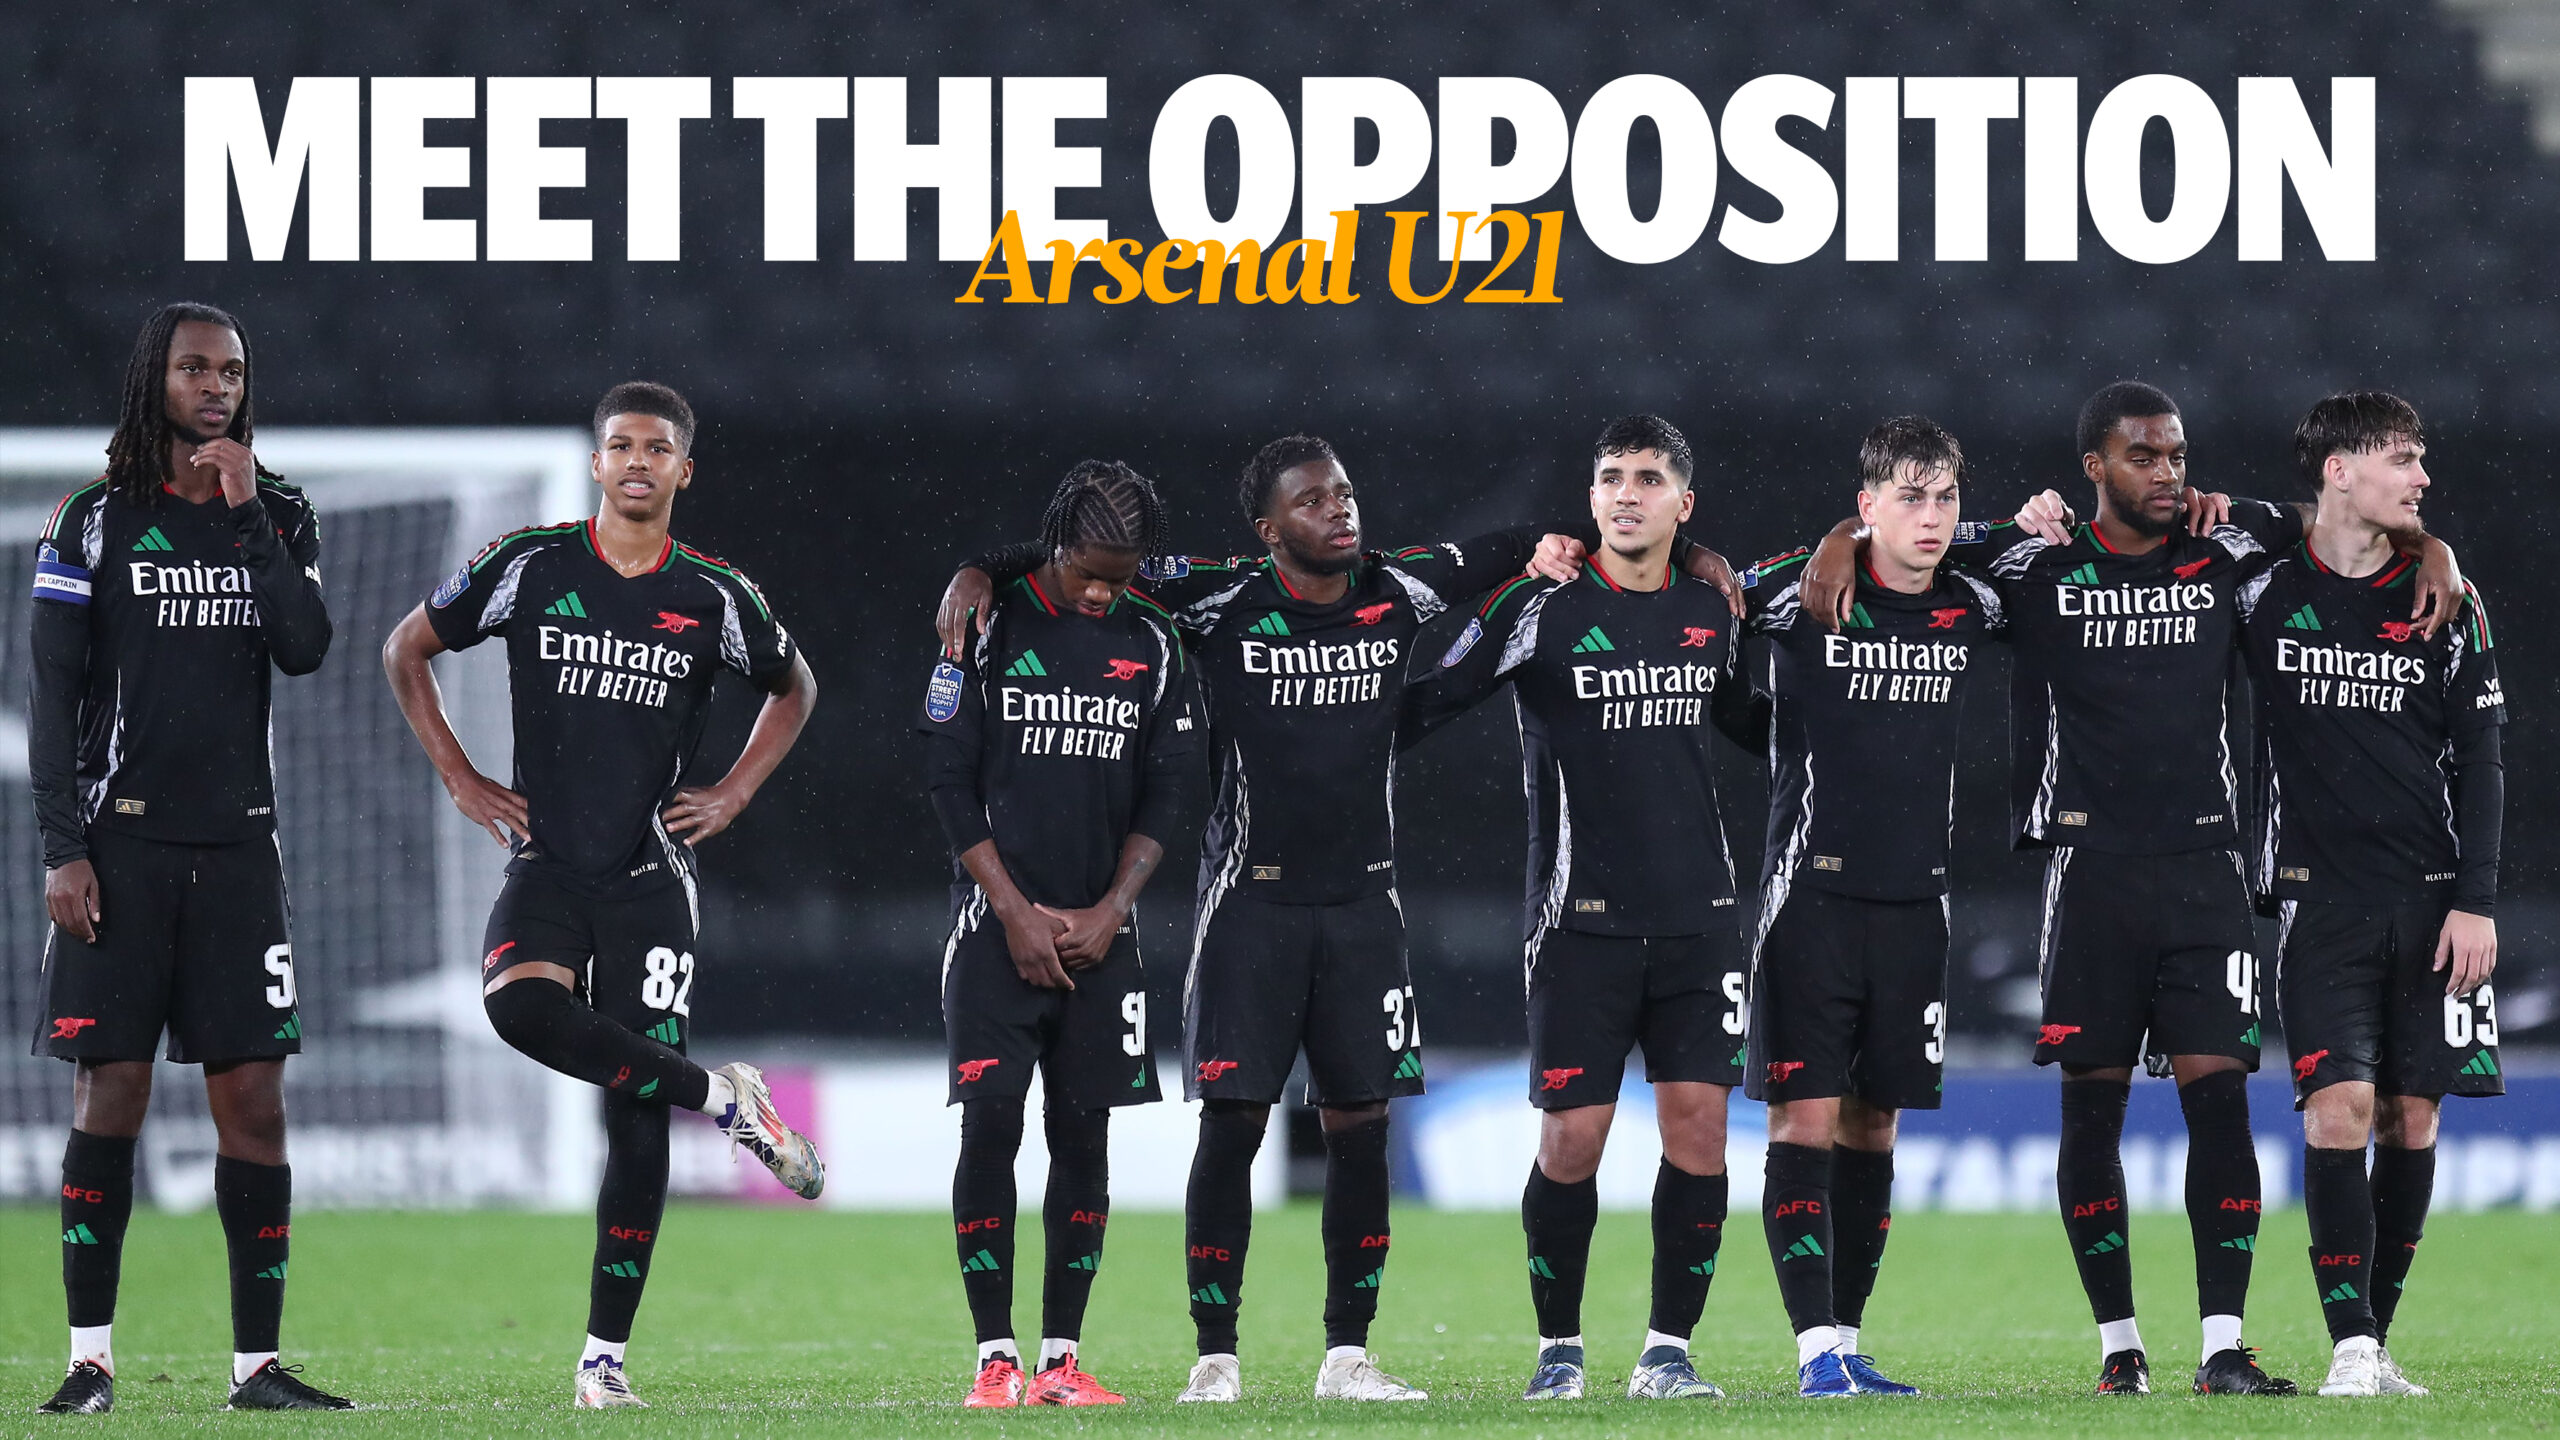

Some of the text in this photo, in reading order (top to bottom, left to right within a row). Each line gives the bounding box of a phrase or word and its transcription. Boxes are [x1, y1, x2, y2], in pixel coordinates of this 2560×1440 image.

[47, 578, 77, 589] CAPTAIN
[129, 559, 252, 596] Emirat
[157, 599, 191, 627] FLY
[2056, 581, 2215, 616] Emirates
[2083, 616, 2197, 648] FLY BETTER
[538, 626, 693, 678] Emirates
[1240, 637, 1399, 675] Emirates
[1824, 634, 1969, 672] Emirates
[2276, 638, 2426, 685] Emirates
[557, 666, 668, 708] FLY BETTER
[931, 684, 957, 695] STREET
[932, 677, 959, 689] BRISTOL
[1270, 672, 1382, 706] FLY BETTER
[1571, 659, 1717, 699] Emirates
[1847, 673, 1952, 703] FLY BETTER
[2299, 678, 2405, 712] FLY BETTER
[930, 692, 955, 701] MOTORS
[930, 698, 953, 707] TROPHY
[1001, 686, 1140, 730] Emirates
[1602, 698, 1702, 730] FLY BETTER
[1021, 727, 1126, 761] FLY BETTER
[641, 946, 695, 1019] 82
[2443, 984, 2499, 1049] 63
[62, 1184, 103, 1204] AFC
[1775, 1200, 1821, 1218] AFC
[2073, 1197, 2119, 1218] AFC
[609, 1226, 652, 1242] AFC
[957, 1217, 1000, 1234] AFC
[1190, 1245, 1230, 1262] AFC
[2319, 1254, 2361, 1266] AFC
